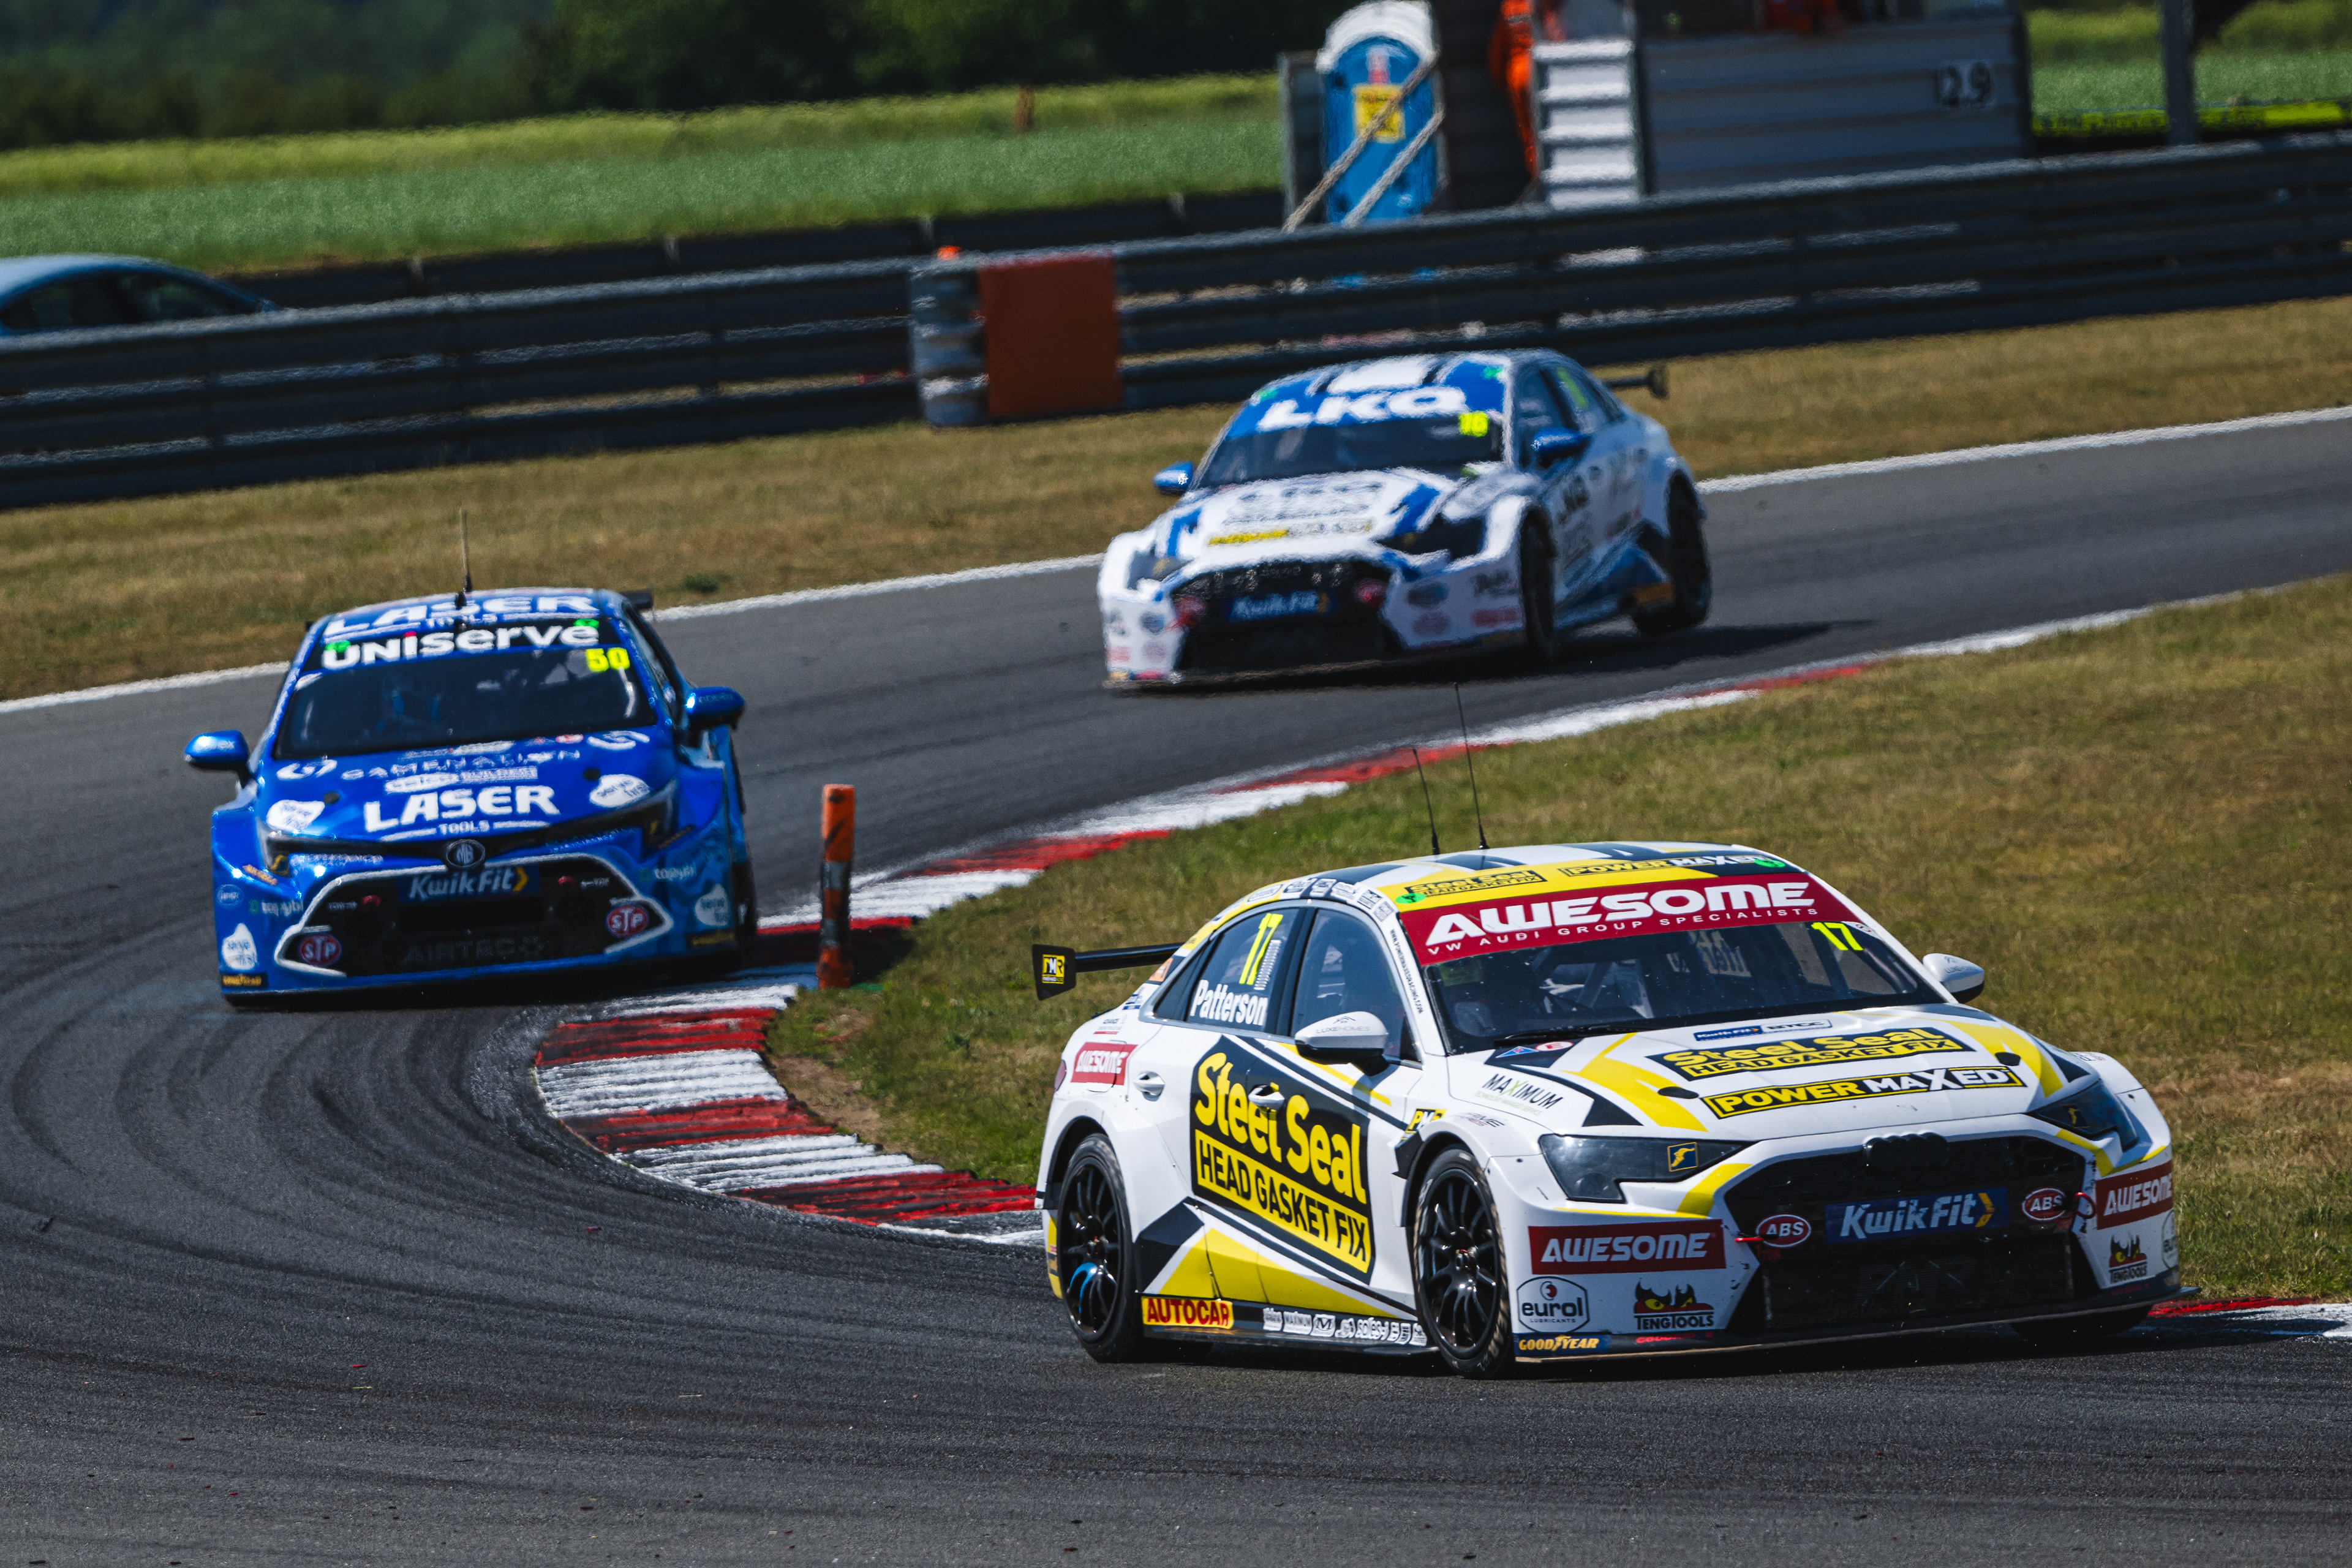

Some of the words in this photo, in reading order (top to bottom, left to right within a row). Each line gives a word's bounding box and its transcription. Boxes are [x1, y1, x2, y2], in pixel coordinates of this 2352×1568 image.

[1256, 386, 1467, 430] LKQ
[323, 595, 600, 636] LASER
[586, 647, 630, 673] 50
[364, 785, 560, 832] LASER
[439, 820, 490, 835] TOOLS
[1409, 878, 1478, 893] Steel
[1480, 870, 1536, 883] Seal
[1569, 860, 1672, 875] POWER
[612, 907, 644, 938] STP
[1426, 881, 1815, 947] AWESOME
[1479, 930, 1540, 946] AUDI
[1558, 921, 1643, 936] GROUP
[1659, 908, 1819, 925] SPECIALISTS
[305, 935, 337, 962] STP
[1238, 913, 1284, 985] 17
[1811, 922, 1864, 951] 17
[1189, 979, 1268, 1026] Patterson
[1075, 1049, 1129, 1074] AWESOME
[1663, 1040, 1817, 1066] Steel
[1816, 1028, 1945, 1049] Seal
[1694, 1057, 1776, 1076] HEAD
[1777, 1046, 1897, 1066] GASKET
[1903, 1040, 1950, 1051] FIX
[1482, 1073, 1564, 1109] MAXIMUM
[1722, 1081, 1866, 1112] POWER
[1864, 1068, 2003, 1093] MAXED
[1194, 1052, 1282, 1163] Steel
[1286, 1095, 1367, 1204] Seal
[1199, 1139, 1251, 1201] HEAD
[1254, 1169, 1330, 1243] GASKET
[1333, 1207, 1368, 1263] FIX
[2029, 1194, 2064, 1212] ABS
[1766, 1221, 1804, 1237] ABS
[1540, 1232, 1711, 1262] AWESOME
[1146, 1298, 1229, 1328] AUTOCAR
[1521, 1297, 1584, 1317] eurol
[1518, 1335, 1600, 1352] GOODYEAR
